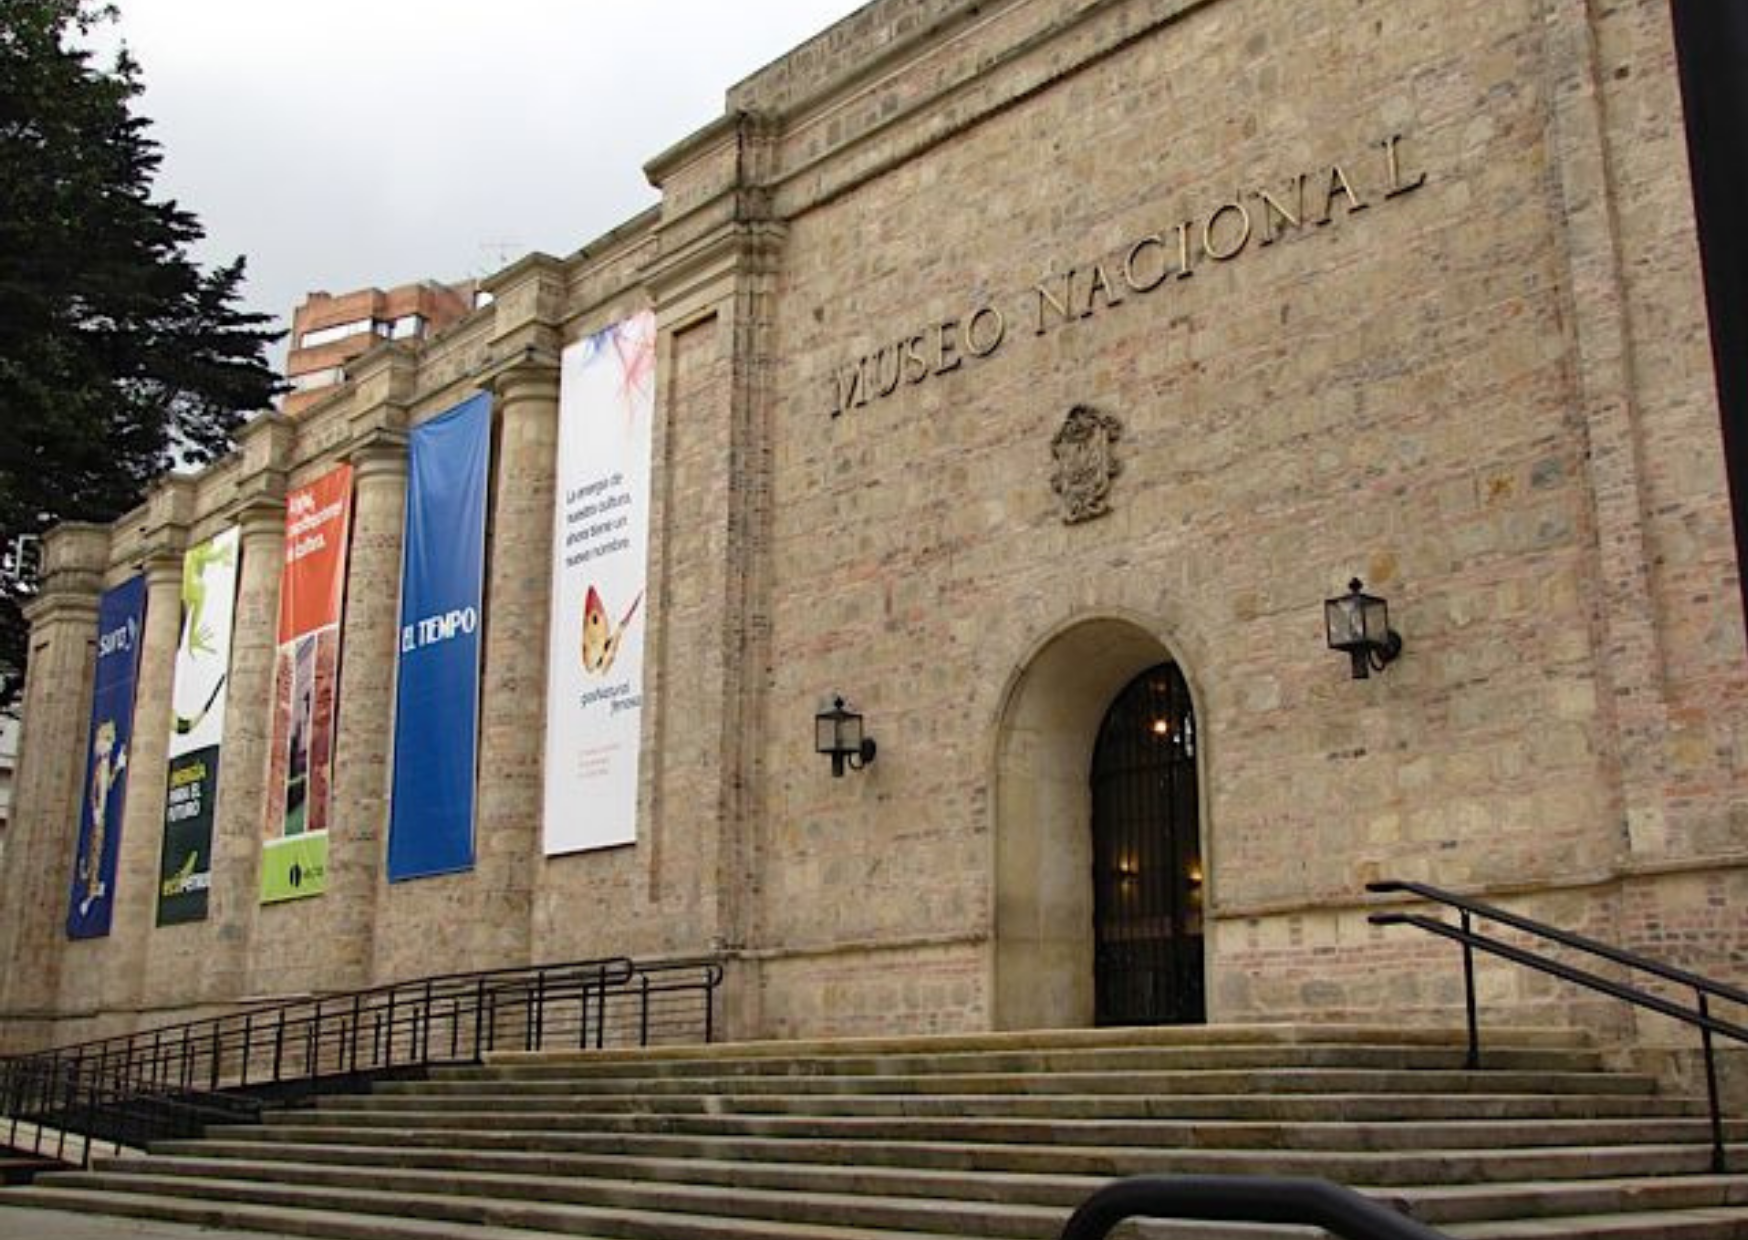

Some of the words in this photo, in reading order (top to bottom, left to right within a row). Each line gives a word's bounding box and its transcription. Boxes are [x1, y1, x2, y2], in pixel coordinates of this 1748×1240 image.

[830, 307, 1006, 419] MUSEO
[1033, 134, 1427, 337] NACIONAL
[402, 624, 416, 653] EL
[418, 606, 476, 648] TIEMPO
